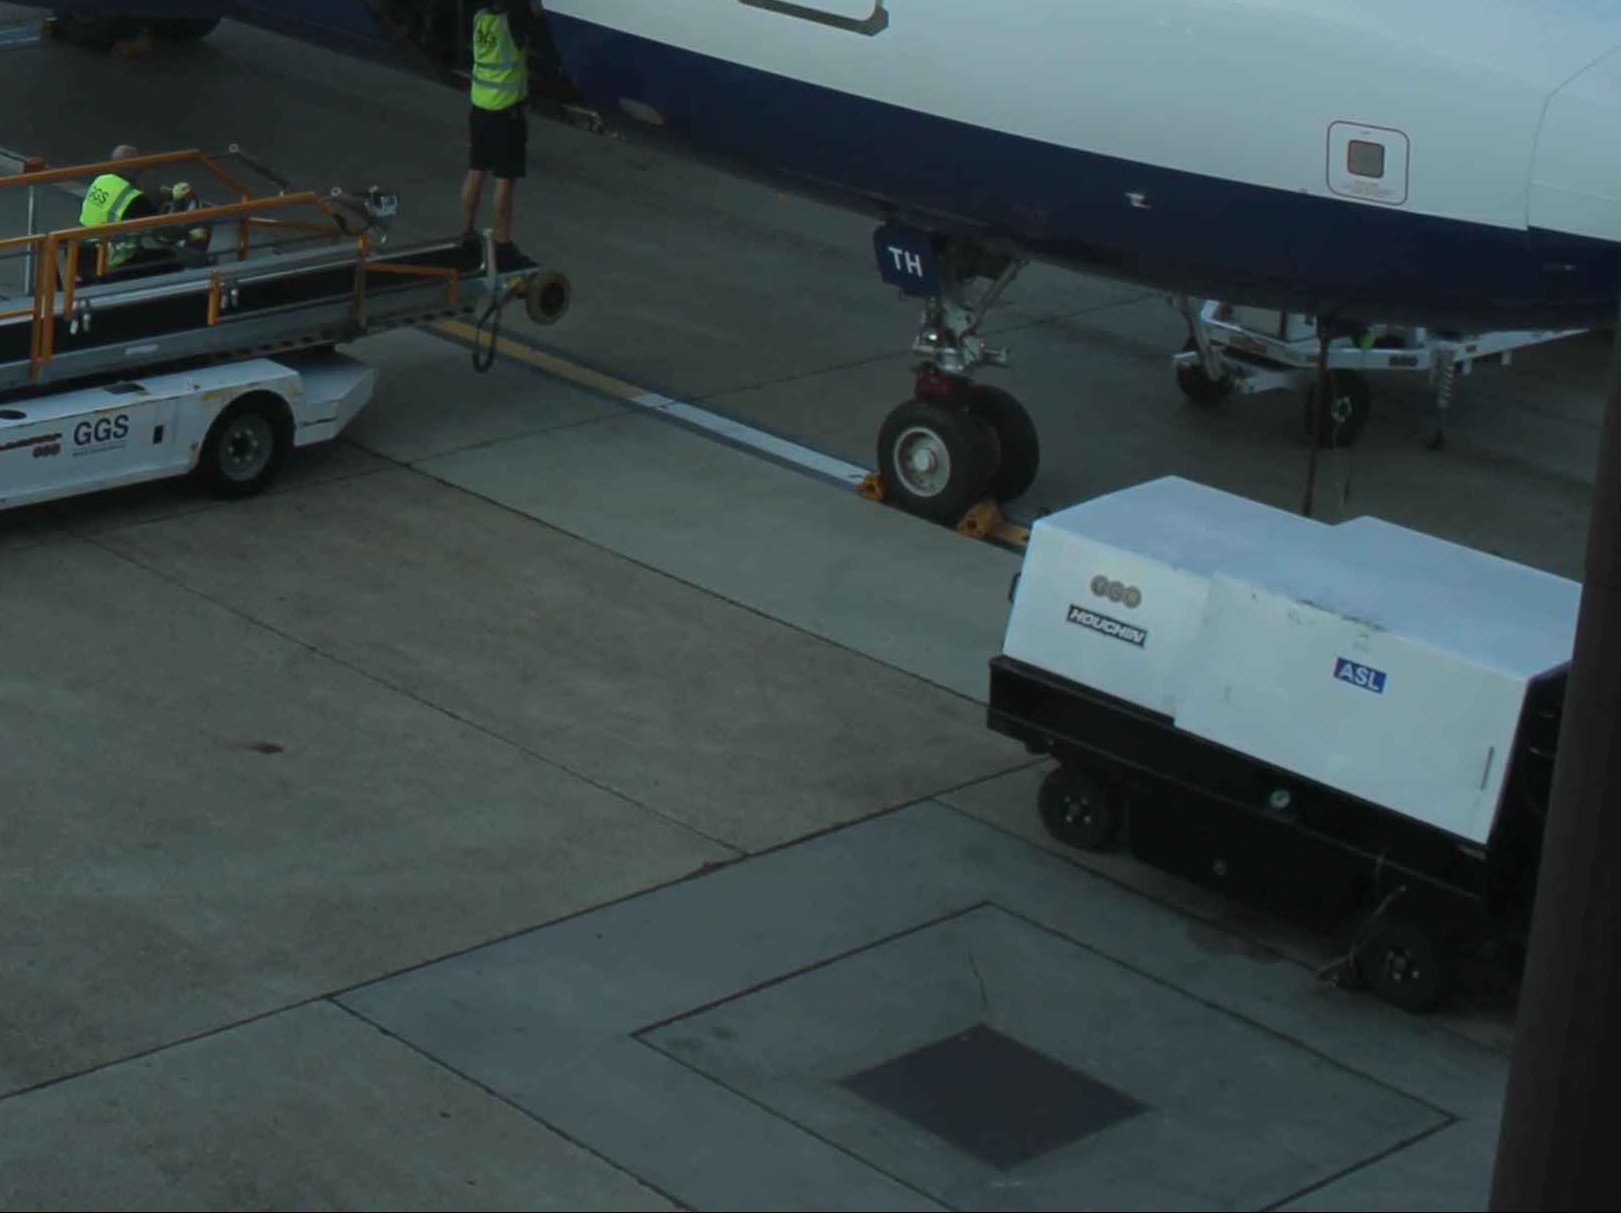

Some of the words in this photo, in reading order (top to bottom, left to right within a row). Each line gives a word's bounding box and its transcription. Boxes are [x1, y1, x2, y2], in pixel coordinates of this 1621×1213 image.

[888, 246, 923, 278] TH
[74, 414, 130, 447] GGS
[1070, 608, 1145, 643] HOUCHIN
[1339, 662, 1381, 692] ASL
